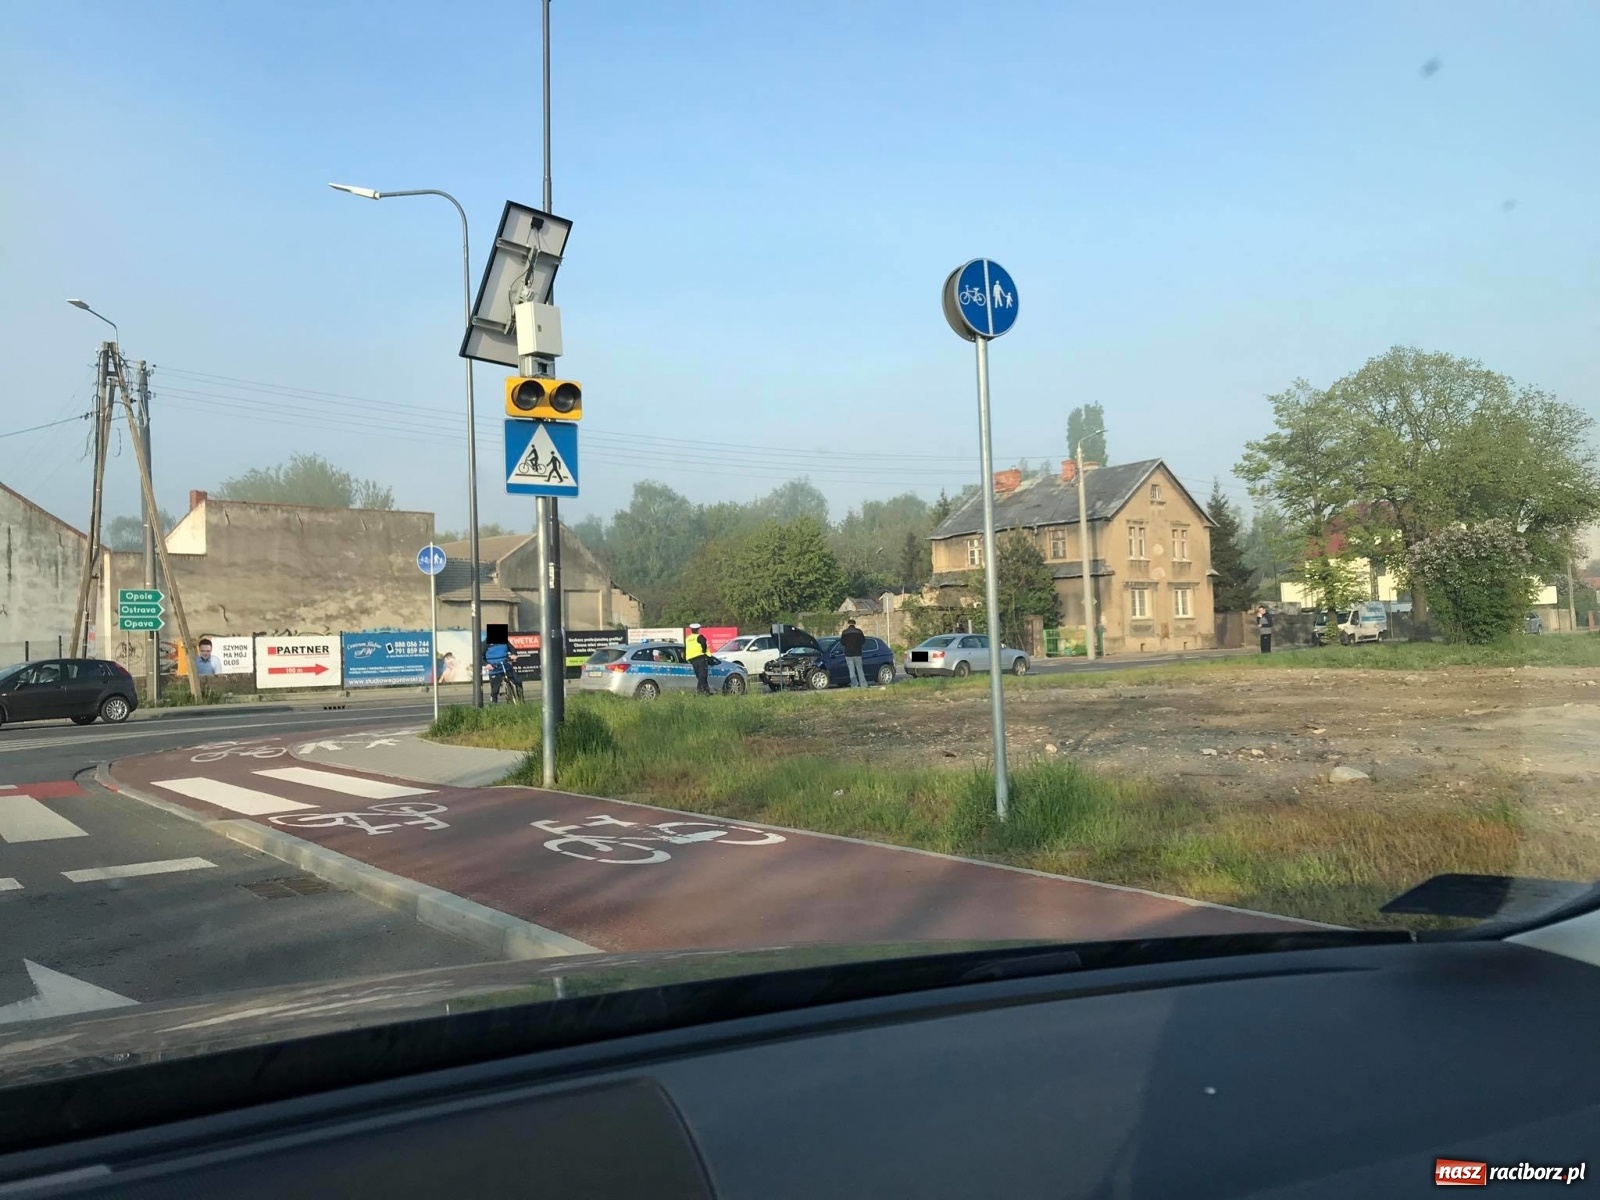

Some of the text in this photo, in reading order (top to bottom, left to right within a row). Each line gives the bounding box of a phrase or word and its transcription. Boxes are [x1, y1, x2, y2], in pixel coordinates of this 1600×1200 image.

[125, 592, 153, 601] Opole
[121, 605, 156, 614] Ostrava
[124, 619, 154, 628] Opava
[509, 637, 539, 645] EWETKA
[277, 645, 329, 654] PARTNER
